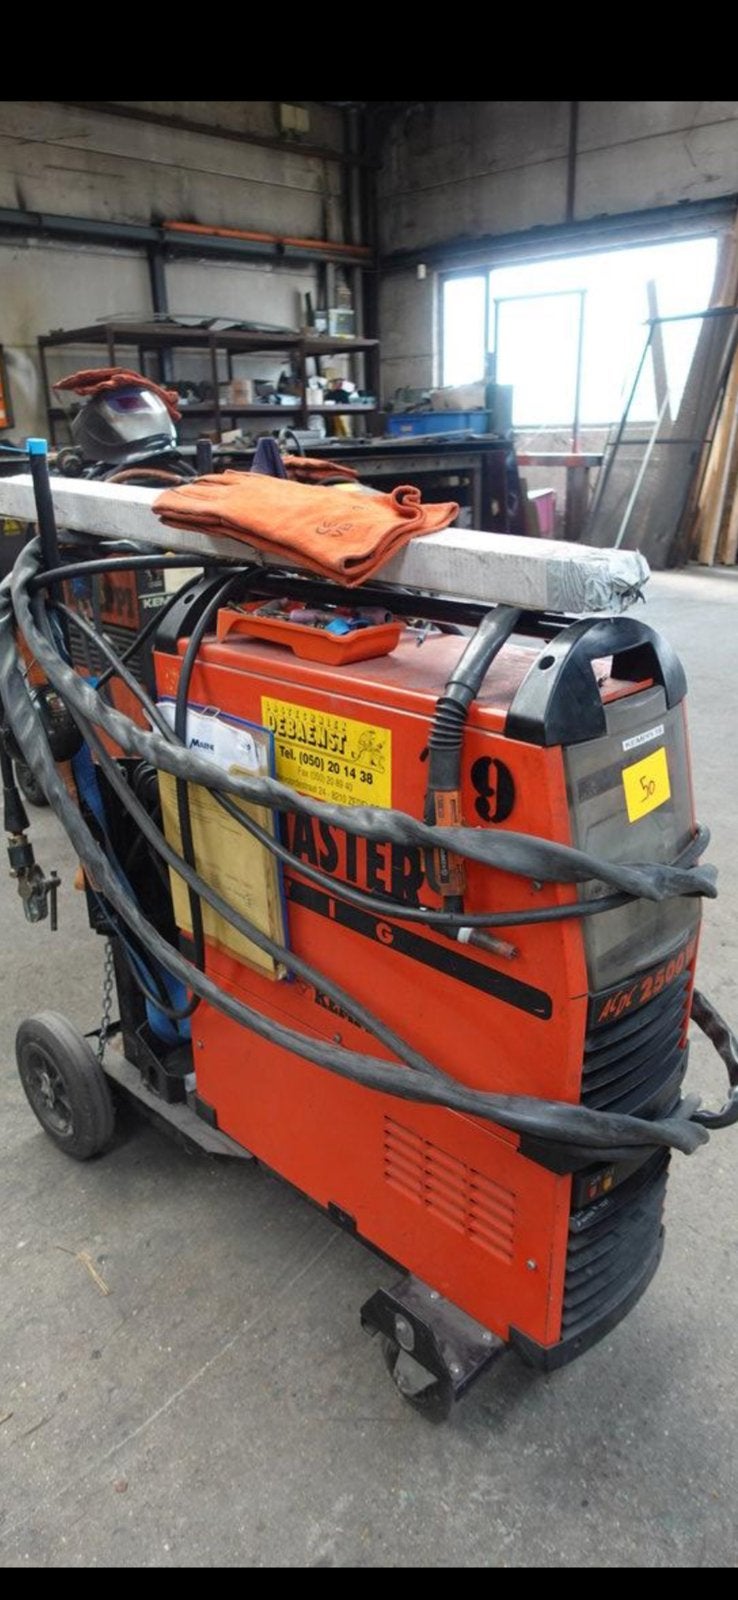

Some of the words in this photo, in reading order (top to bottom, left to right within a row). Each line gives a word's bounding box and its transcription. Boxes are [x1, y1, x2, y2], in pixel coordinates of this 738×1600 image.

[280, 745, 296, 761] Tel.
[299, 752, 324, 771] (050)
[328, 760, 340, 774] 20
[344, 766, 356, 779] 14
[360, 771, 373, 785] 38
[639, 775, 656, 803] 50
[283, 810, 424, 908] ASTER
